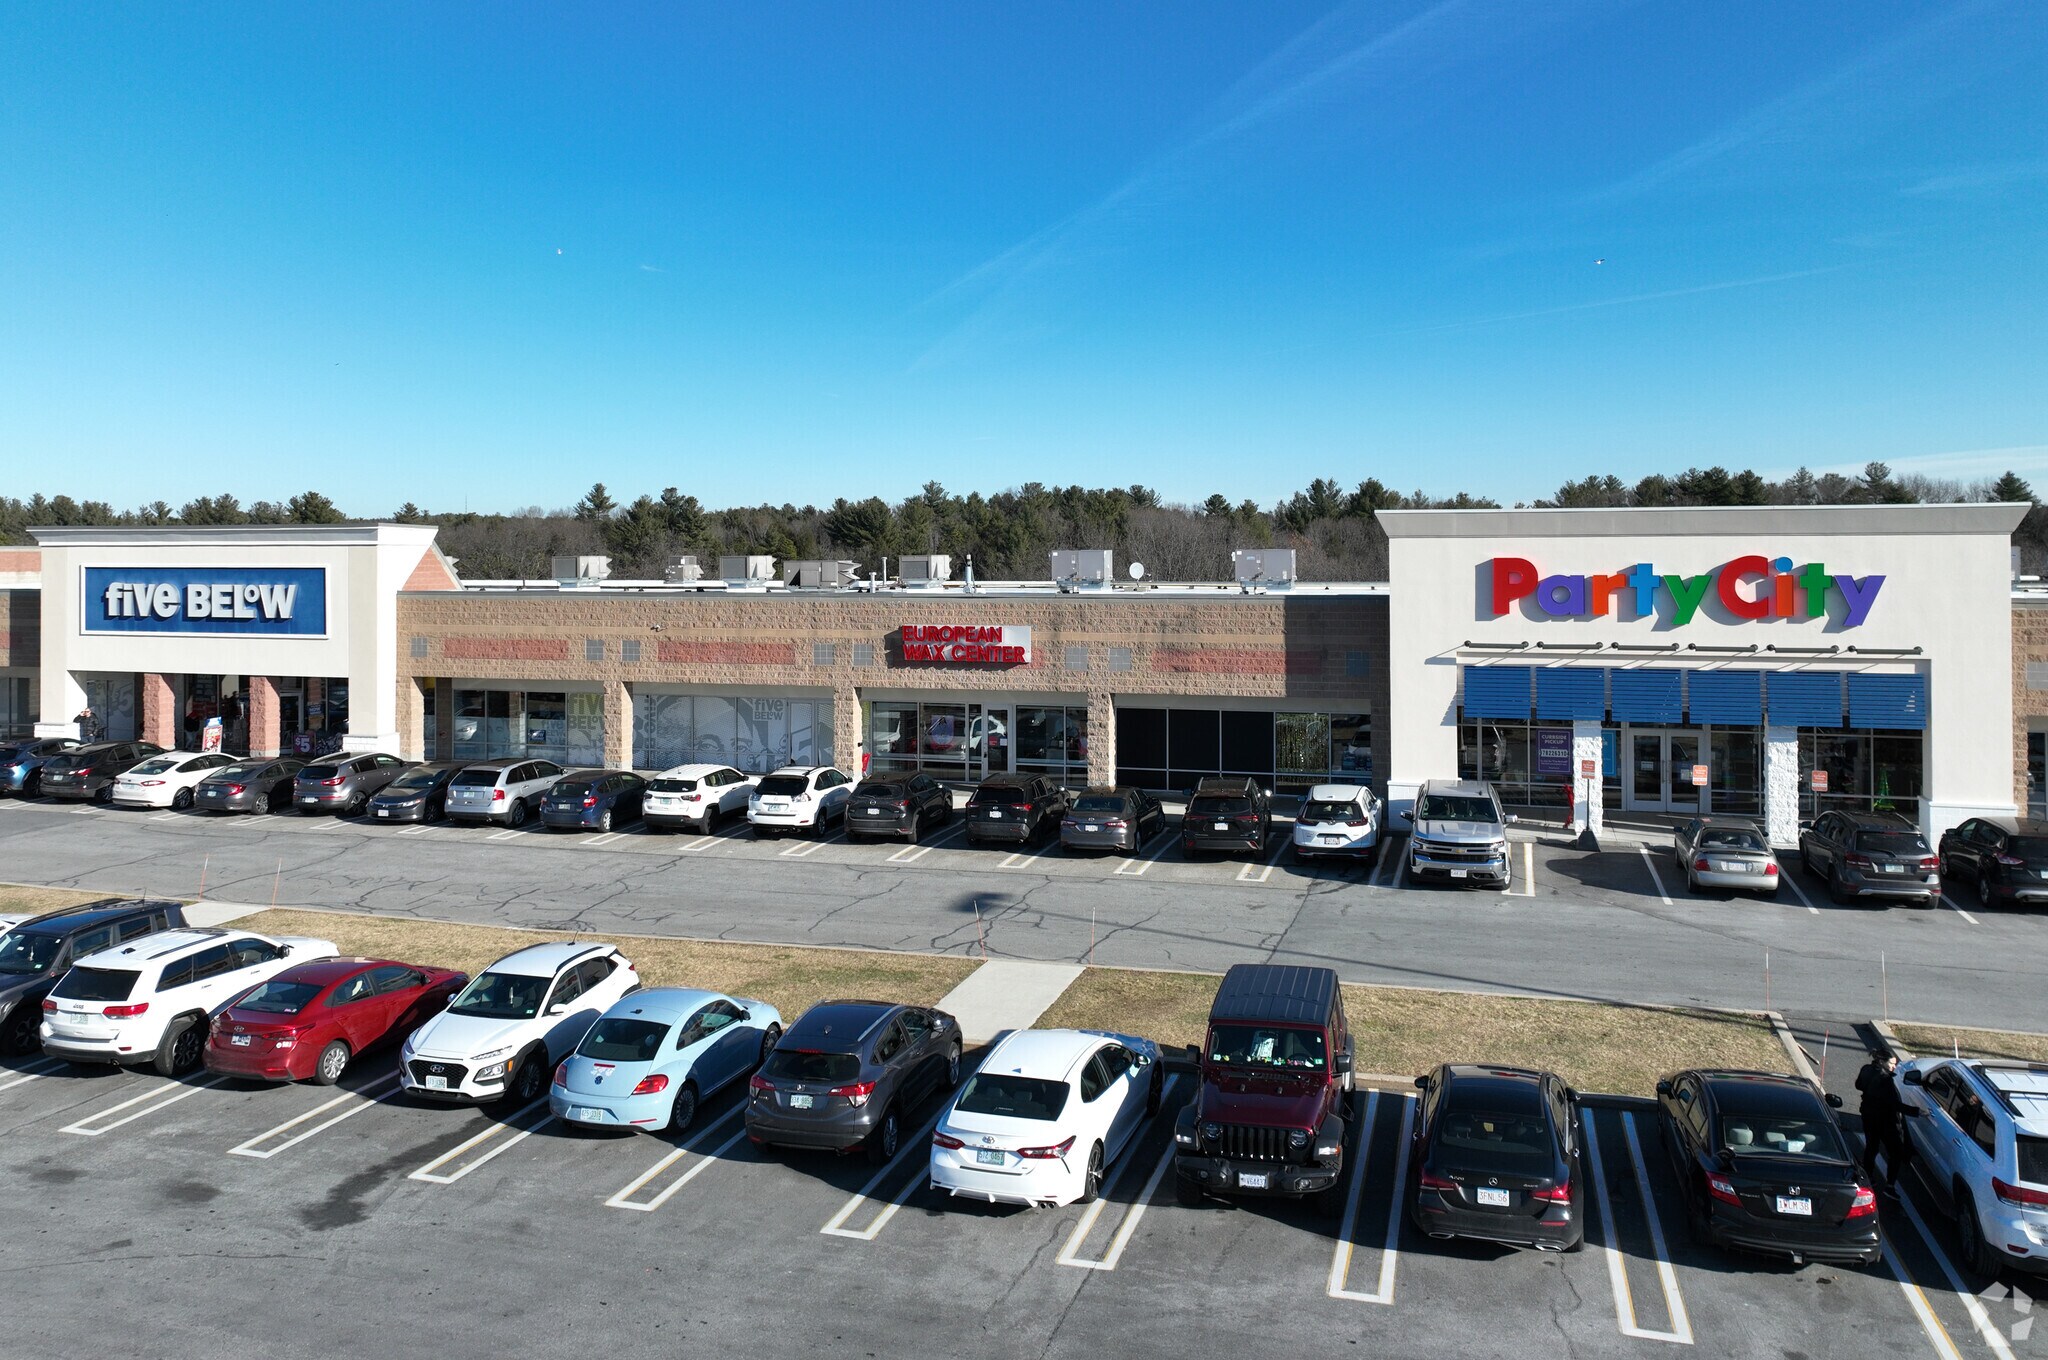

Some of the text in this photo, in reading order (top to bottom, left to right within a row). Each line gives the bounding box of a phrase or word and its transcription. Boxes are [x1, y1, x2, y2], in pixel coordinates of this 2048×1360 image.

[902, 625, 1003, 643] EUROPEAN
[902, 645, 1026, 663] WAX CENTER
[295, 737, 311, 753] $5
